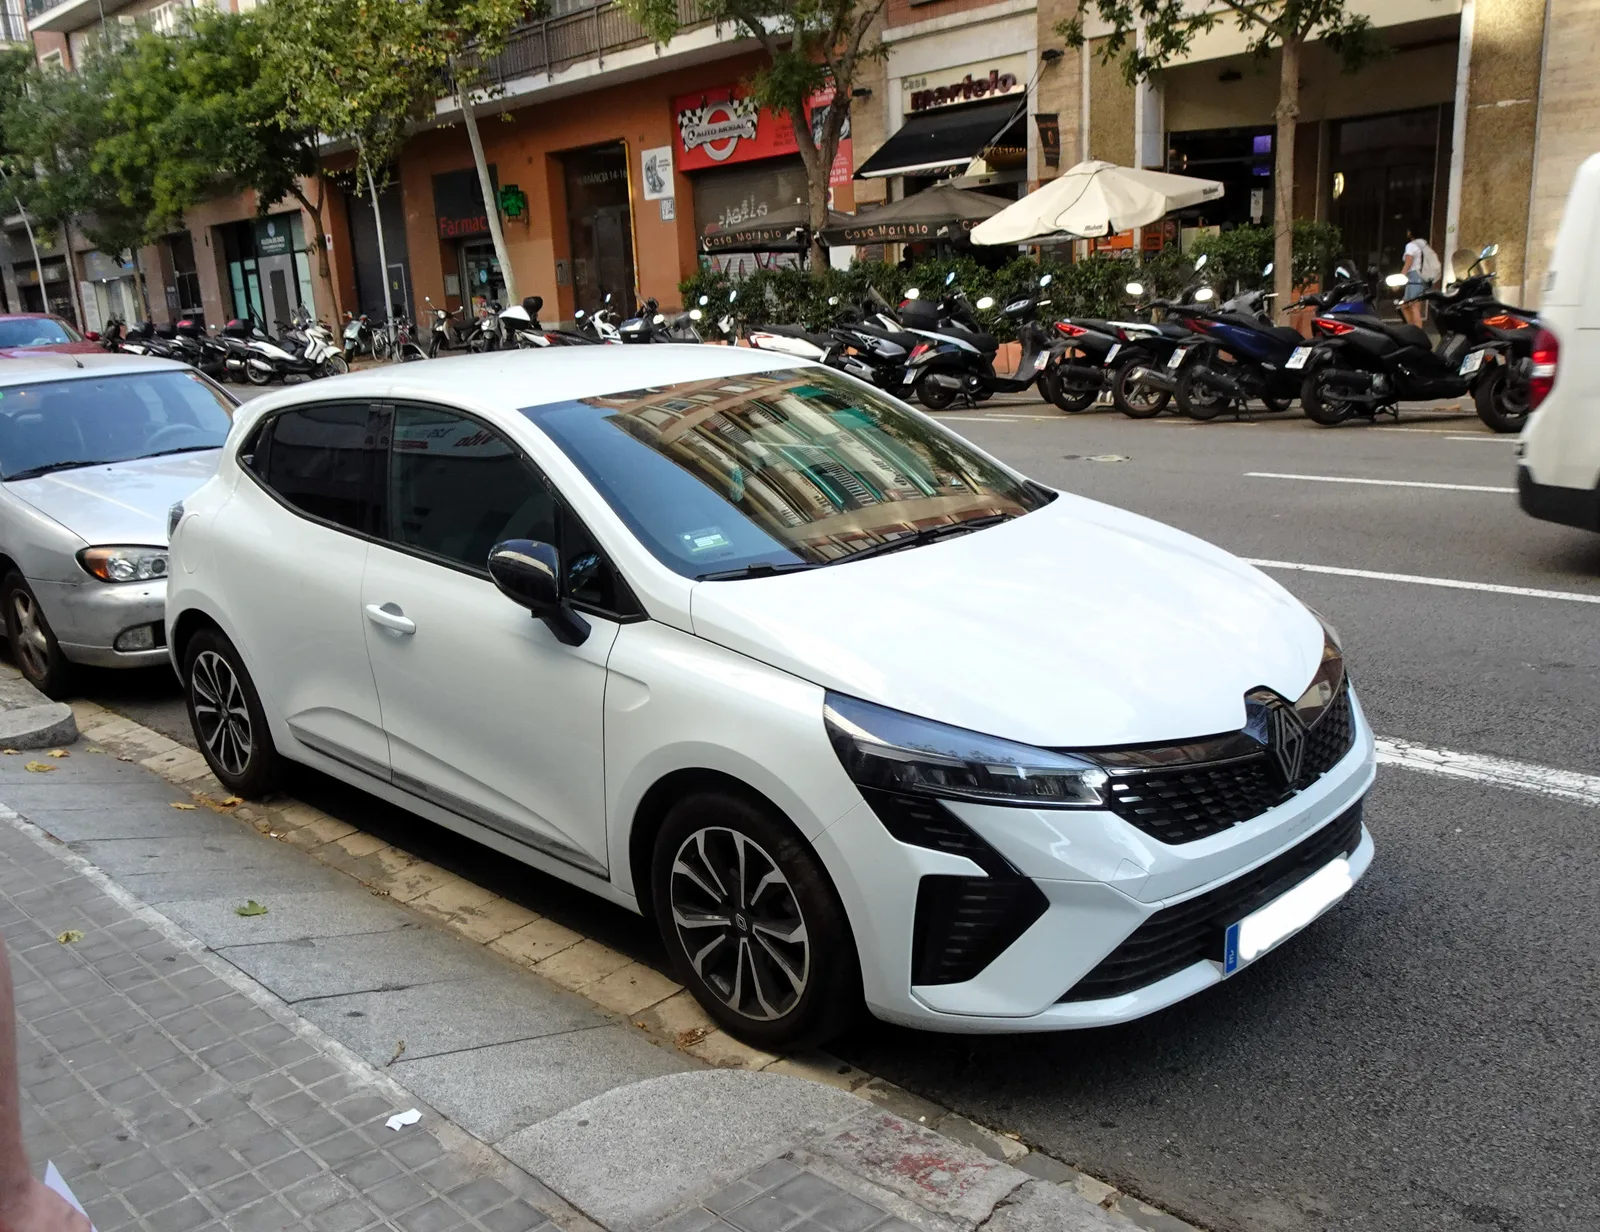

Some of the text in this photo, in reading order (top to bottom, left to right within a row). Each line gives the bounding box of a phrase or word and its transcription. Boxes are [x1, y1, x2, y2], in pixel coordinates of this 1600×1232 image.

[911, 70, 1017, 110] martelo
[696, 130, 717, 138] AUTO
[705, 230, 781, 247] Casa Martelo
[844, 224, 928, 239] Casa Martelo
